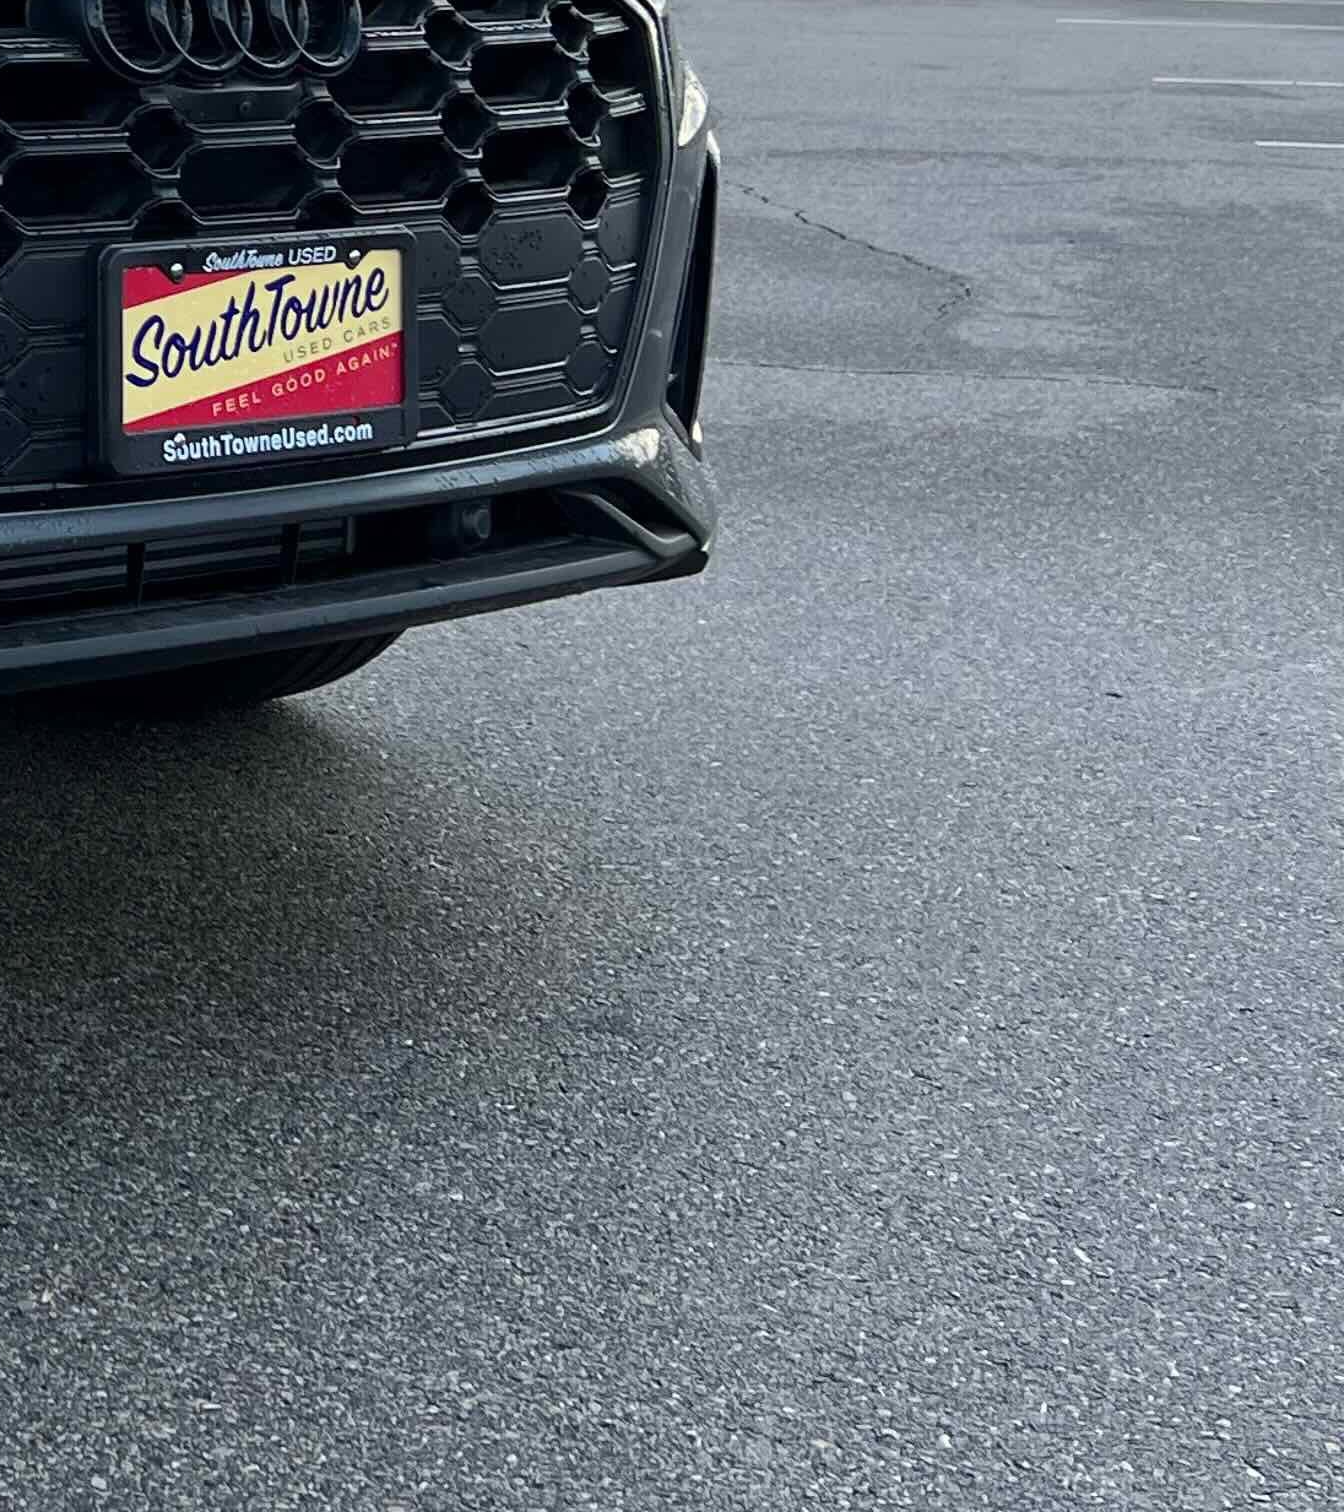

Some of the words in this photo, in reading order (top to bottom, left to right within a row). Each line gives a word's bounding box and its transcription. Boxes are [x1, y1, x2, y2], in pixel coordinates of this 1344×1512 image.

[288, 245, 337, 265] USED
[283, 338, 333, 364] USED
[343, 316, 392, 343] CARS
[212, 391, 262, 417] FEEL
[272, 368, 326, 397] GOOD
[162, 422, 374, 463] SouthTowneUsed.com
